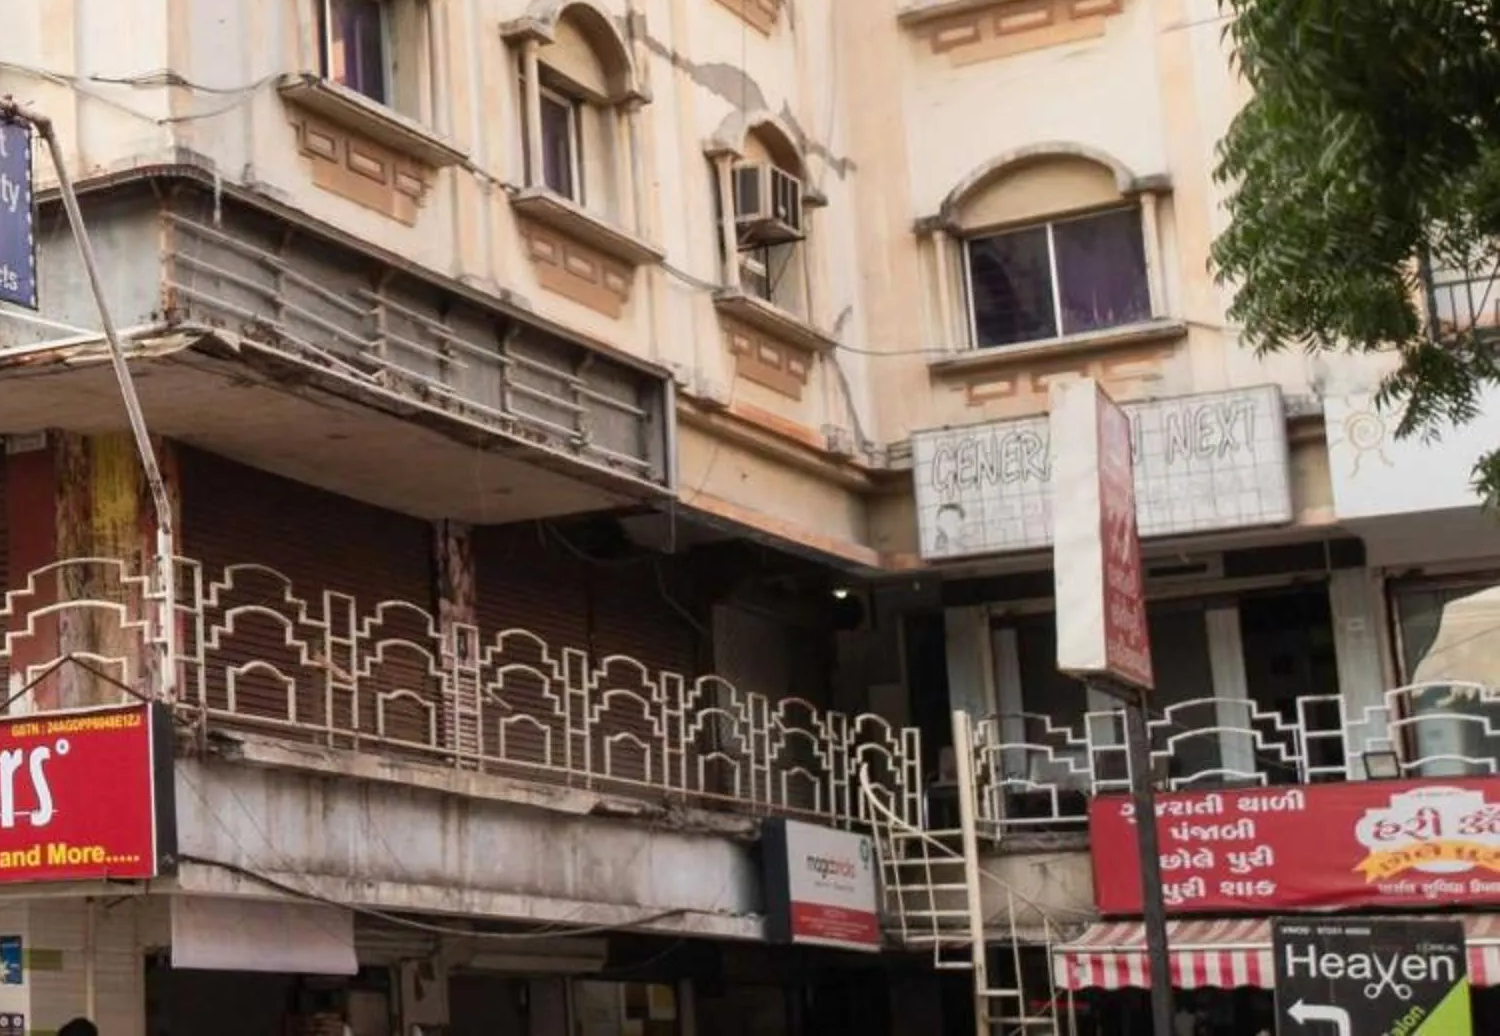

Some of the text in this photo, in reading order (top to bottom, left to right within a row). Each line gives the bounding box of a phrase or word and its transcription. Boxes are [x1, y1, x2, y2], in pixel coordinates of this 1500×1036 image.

[1164, 398, 1257, 466] NEXT
[1169, 817, 1256, 842] પંજાબી
[0, 845, 41, 868] and
[1227, 844, 1274, 873] પુરી
[1219, 879, 1277, 897] શાક
[1285, 943, 1455, 1000] Heaven
[1383, 1005, 1426, 1036] alon
